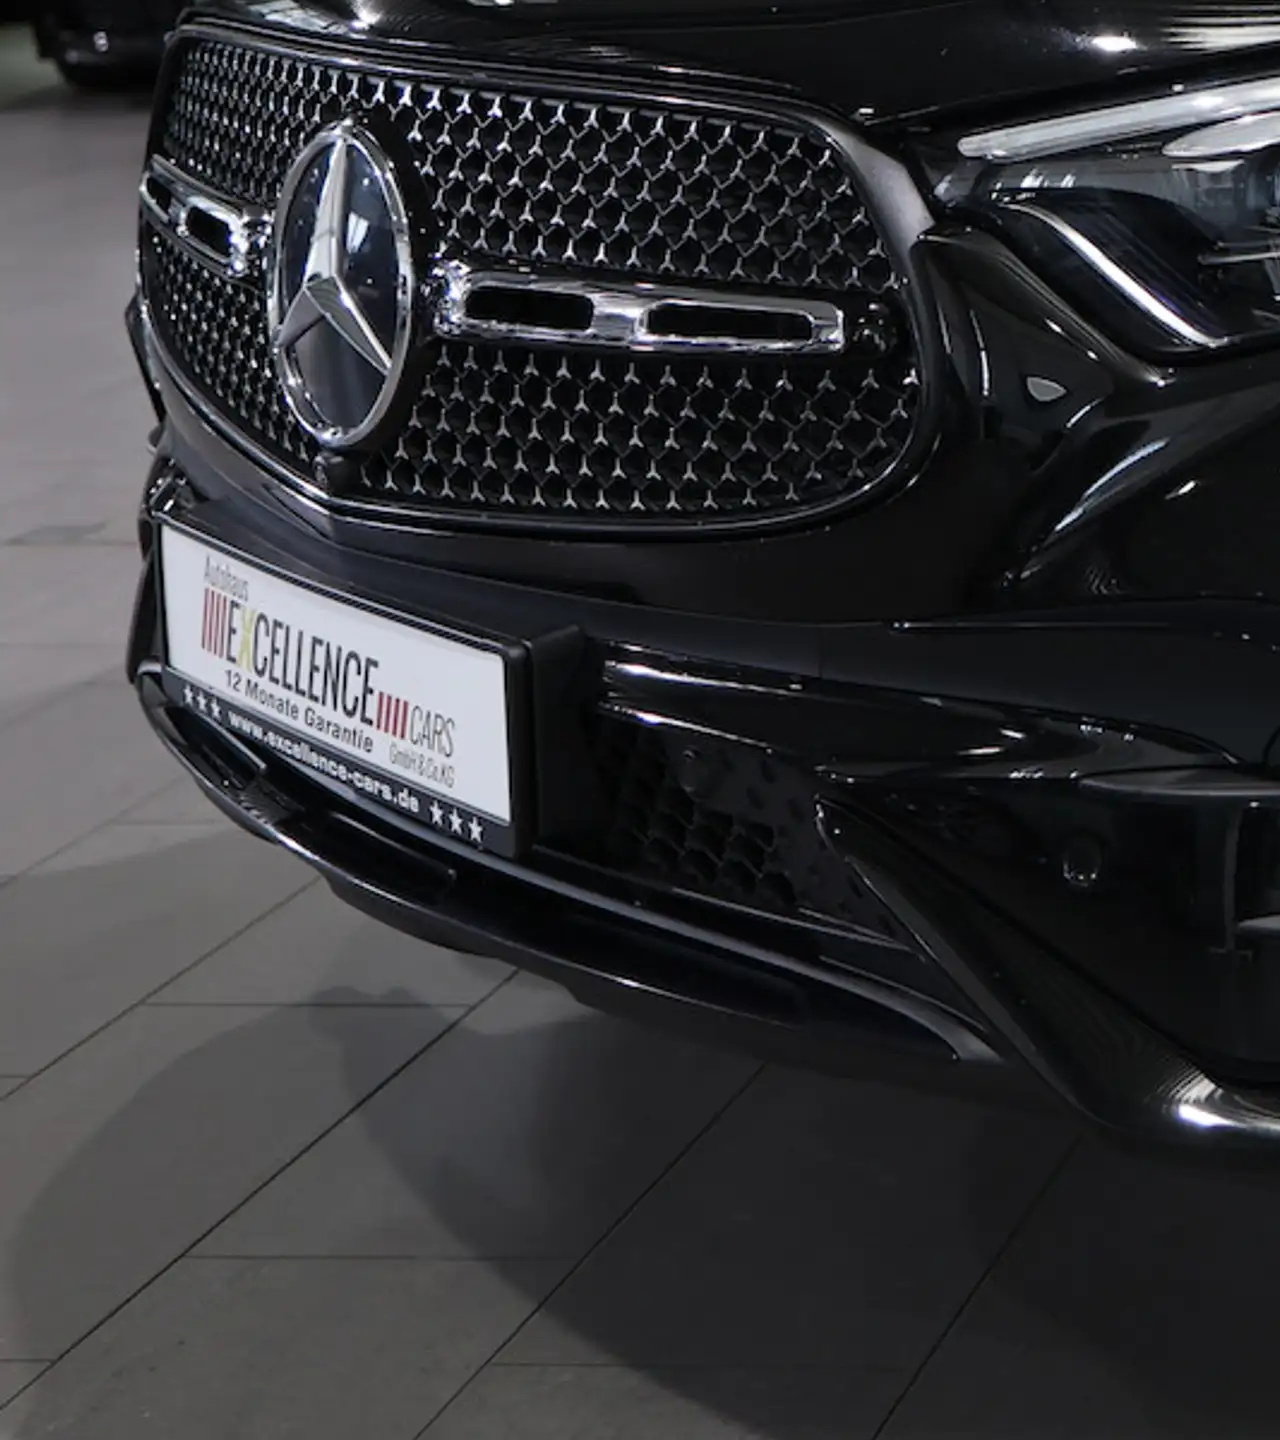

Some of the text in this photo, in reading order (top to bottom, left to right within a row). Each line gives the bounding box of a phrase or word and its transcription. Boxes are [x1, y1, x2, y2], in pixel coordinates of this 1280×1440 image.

[225, 599, 456, 758] EXCELLENCE CARS
[225, 667, 375, 754] 12 Monate Garantie
[228, 710, 420, 813] www.excellence-cars.de
